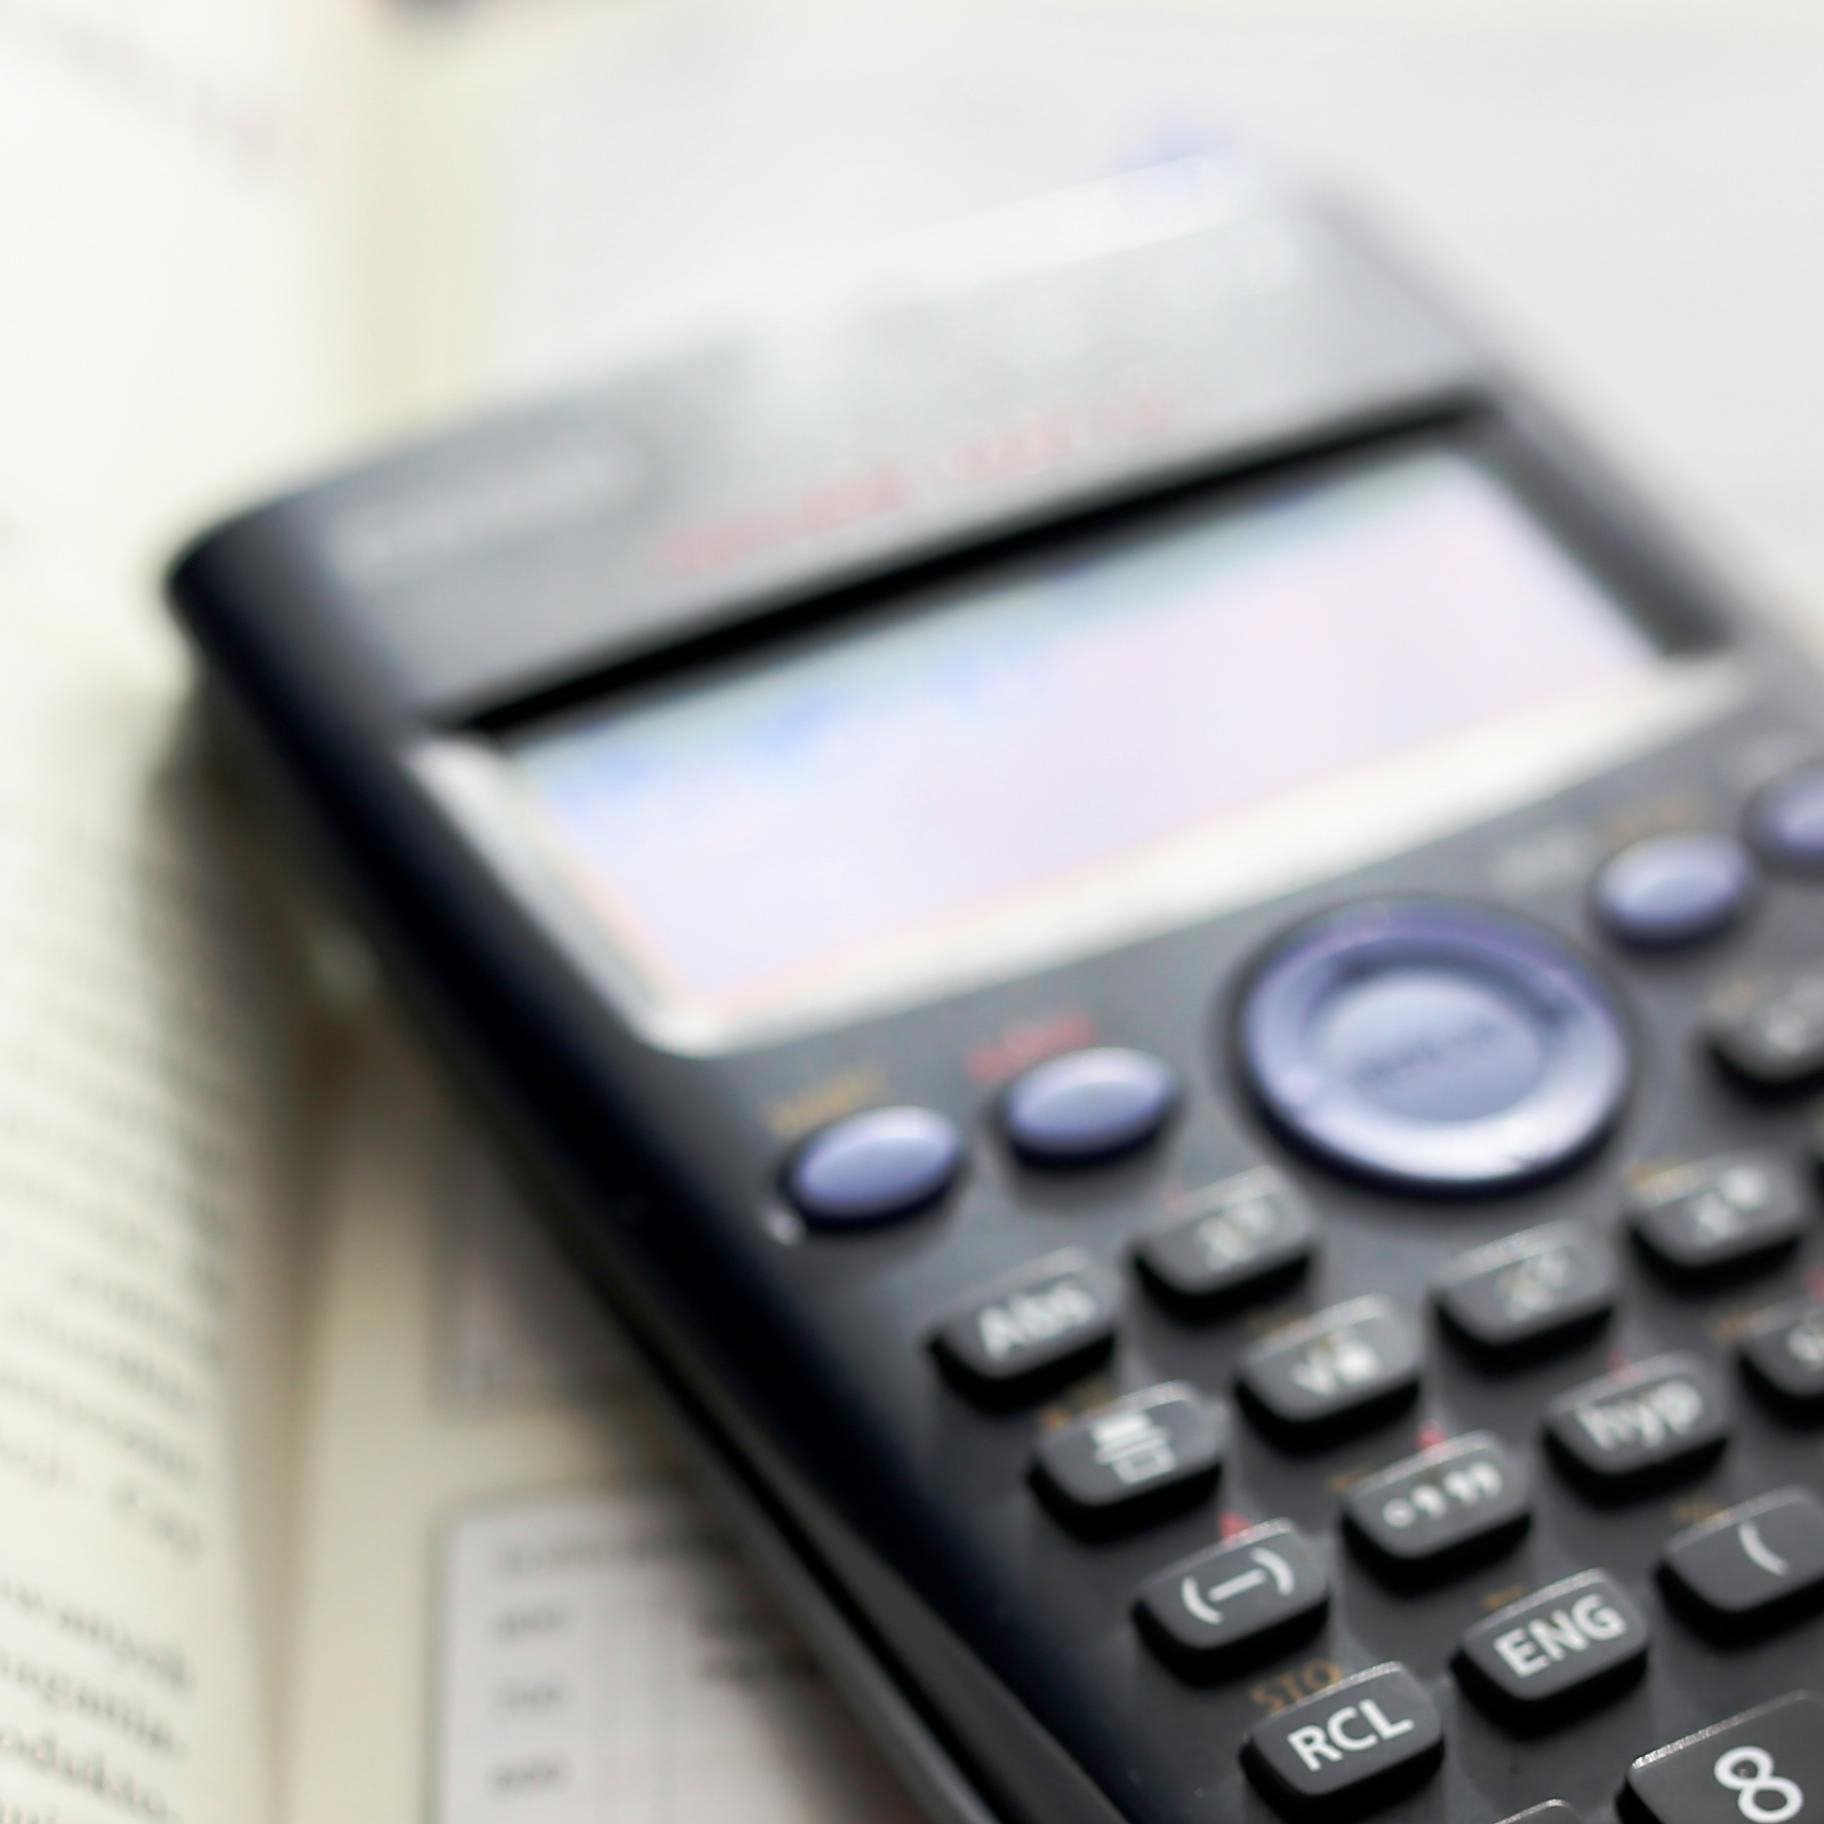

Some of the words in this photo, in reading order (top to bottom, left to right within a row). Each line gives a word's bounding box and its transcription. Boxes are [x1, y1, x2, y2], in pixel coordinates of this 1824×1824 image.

[1493, 1594, 1627, 1680] ENG
[1252, 1656, 1342, 1712] STO
[1287, 1699, 1414, 1772] RCL
[1713, 1746, 1804, 1824] 8
